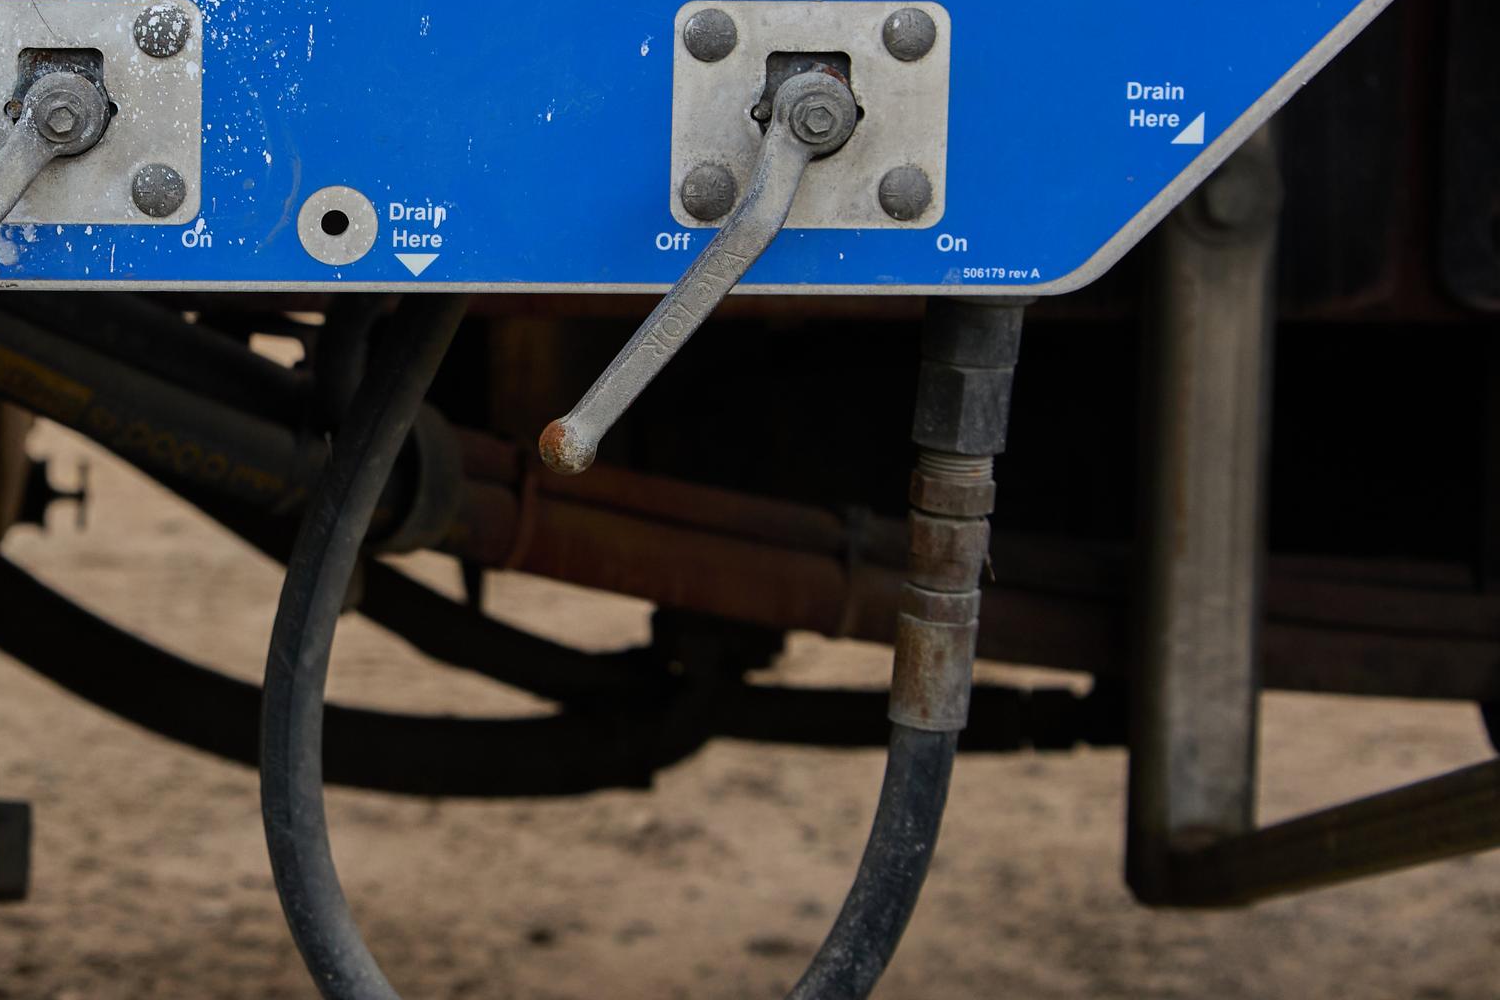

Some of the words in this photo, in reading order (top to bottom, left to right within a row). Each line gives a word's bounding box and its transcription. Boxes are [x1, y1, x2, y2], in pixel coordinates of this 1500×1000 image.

[1127, 82, 1184, 99] Drain
[1130, 110, 1179, 127] Here
[389, 203, 446, 221] Drain
[182, 230, 212, 248] On
[392, 229, 442, 248] Here
[656, 233, 691, 250] Off
[937, 234, 967, 251] On
[964, 268, 1005, 278] 506179
[1031, 269, 1039, 277] A
